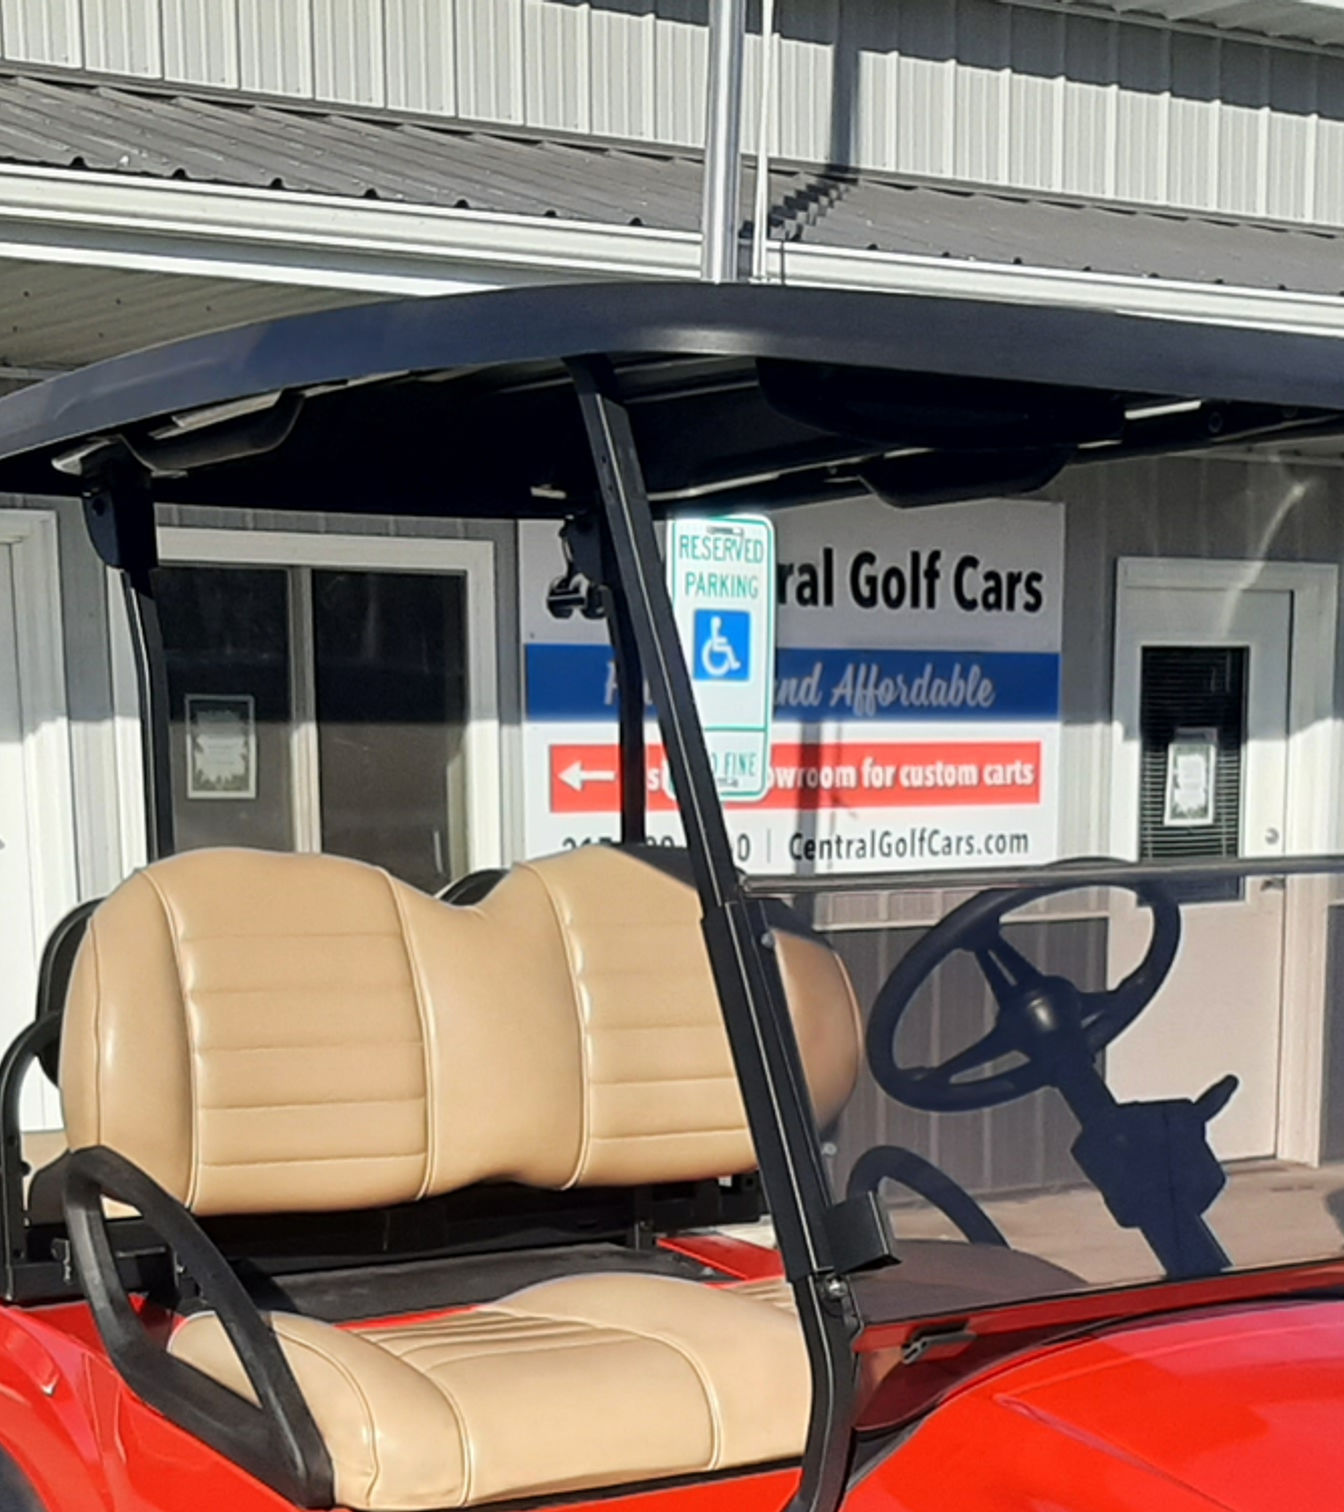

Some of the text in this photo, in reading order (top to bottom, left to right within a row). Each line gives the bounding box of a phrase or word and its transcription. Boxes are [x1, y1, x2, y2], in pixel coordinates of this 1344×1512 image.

[679, 534, 764, 563] RESERVED
[684, 571, 759, 599] PARKING
[850, 550, 941, 610] Golf
[954, 555, 1043, 613] Cars
[774, 661, 996, 718] nd Affordable
[724, 751, 757, 777] FINE
[862, 758, 896, 787] for
[900, 763, 979, 788] custom
[983, 760, 1035, 786] carts
[788, 827, 1029, 861] CentralGolfCars.com
